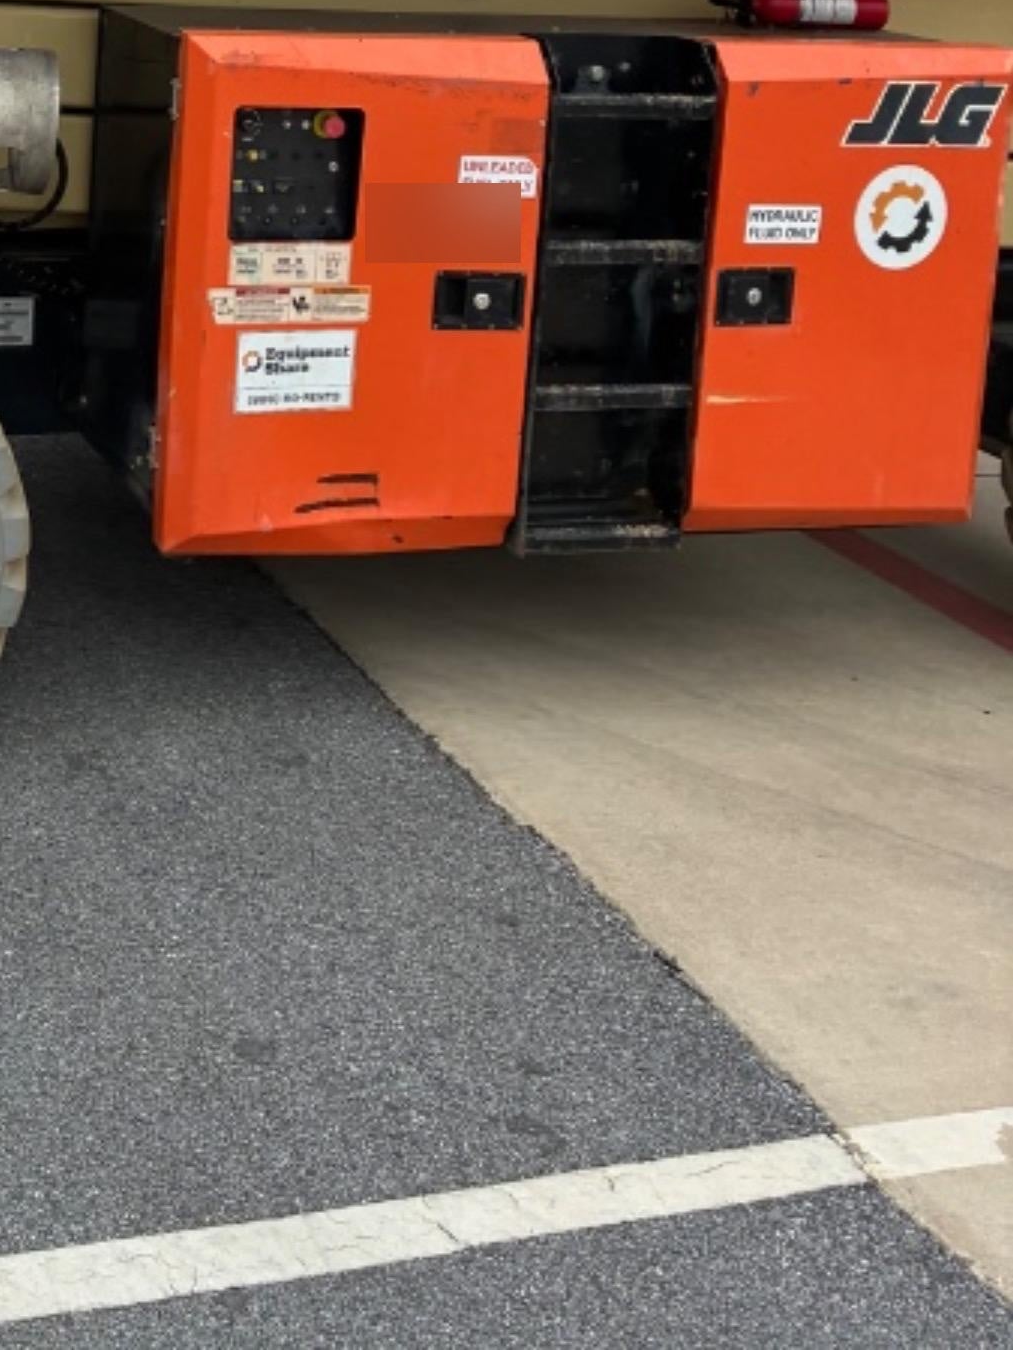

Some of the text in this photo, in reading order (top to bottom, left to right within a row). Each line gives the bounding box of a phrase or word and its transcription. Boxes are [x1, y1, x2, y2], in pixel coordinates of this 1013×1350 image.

[840, 81, 1008, 147] JLG
[265, 345, 350, 361] Equipment
[265, 361, 309, 376] Share
